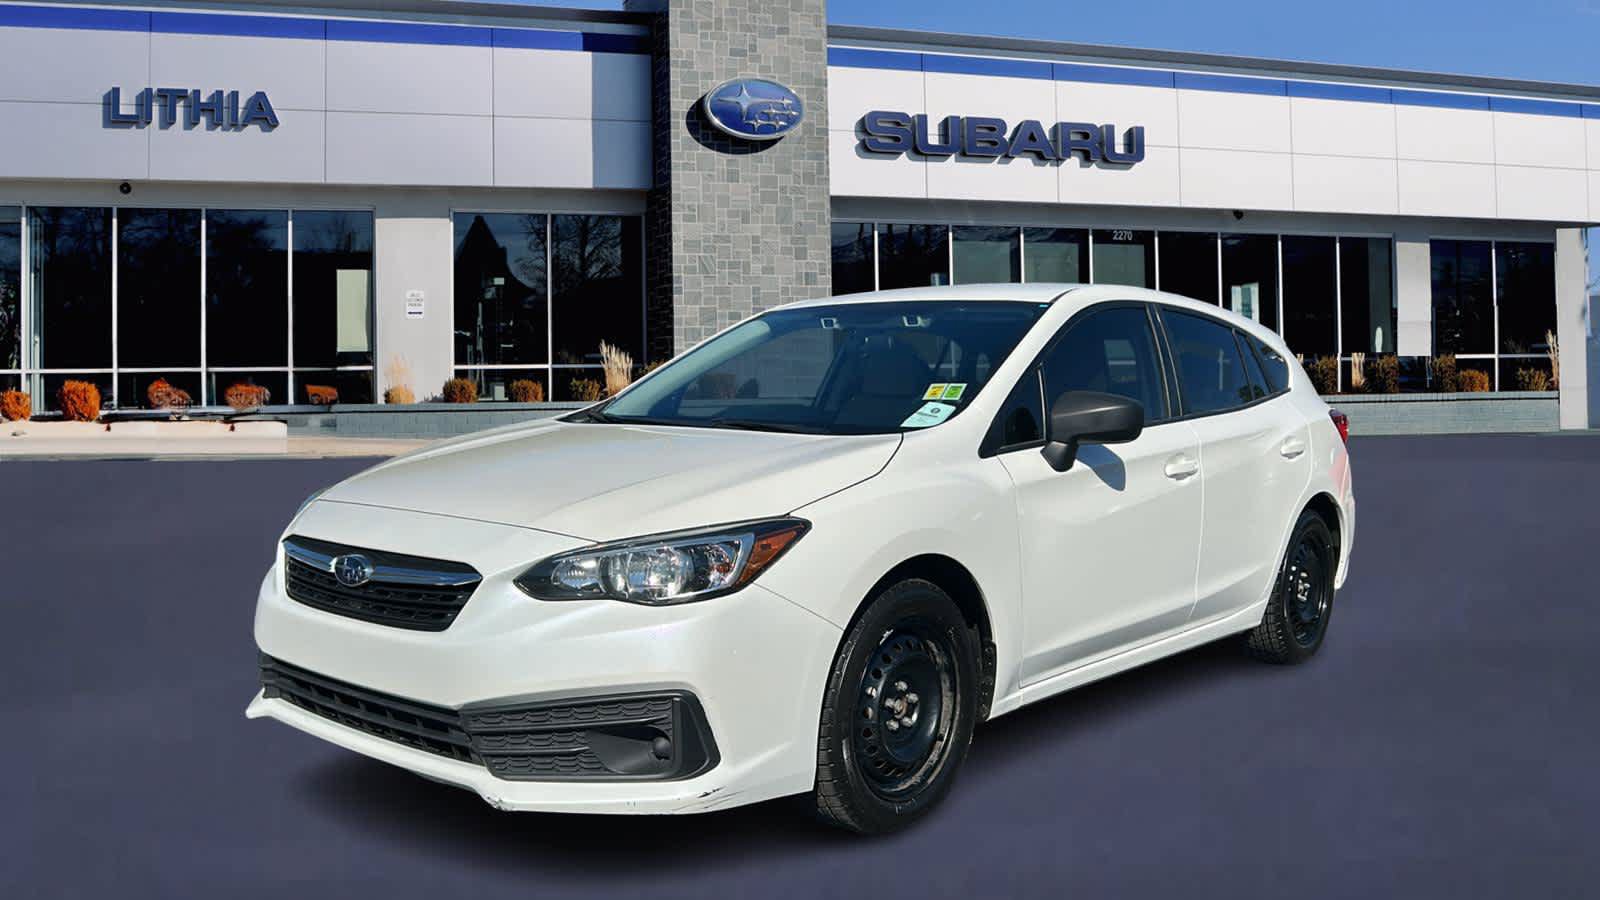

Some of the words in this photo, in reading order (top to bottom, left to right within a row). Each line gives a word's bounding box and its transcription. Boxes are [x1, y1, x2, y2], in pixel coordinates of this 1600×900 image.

[109, 86, 280, 128] LITHIA
[863, 110, 1146, 163] SUBARU
[1112, 230, 1133, 241] 2270
